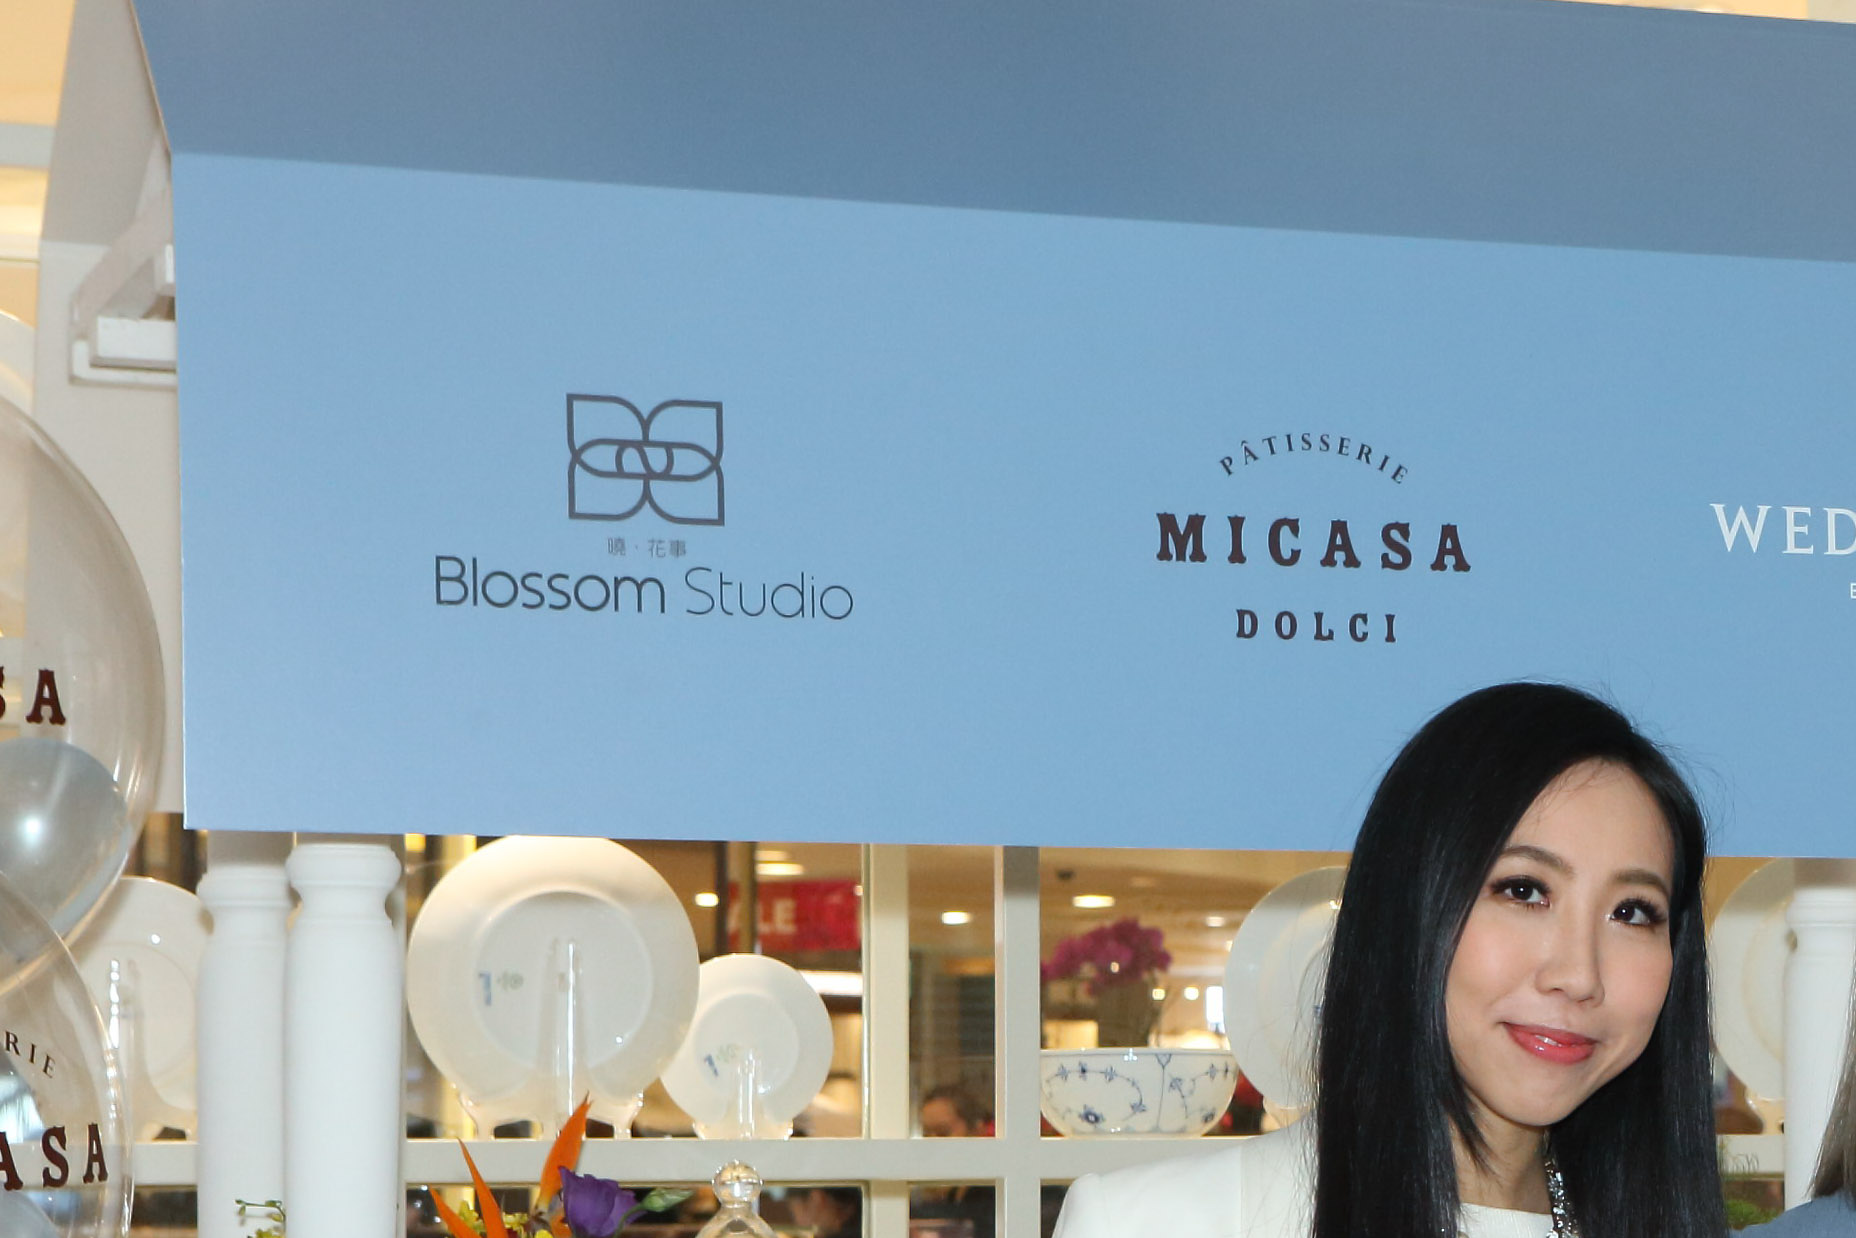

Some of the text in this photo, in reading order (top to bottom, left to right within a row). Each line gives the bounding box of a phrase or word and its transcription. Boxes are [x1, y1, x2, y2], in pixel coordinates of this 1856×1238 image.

[1218, 432, 1409, 484] PÂTISSERIE
[1156, 512, 1471, 572] MICASA
[435, 555, 854, 620] Blossom Studio
[1236, 608, 1396, 642] DOLCI
